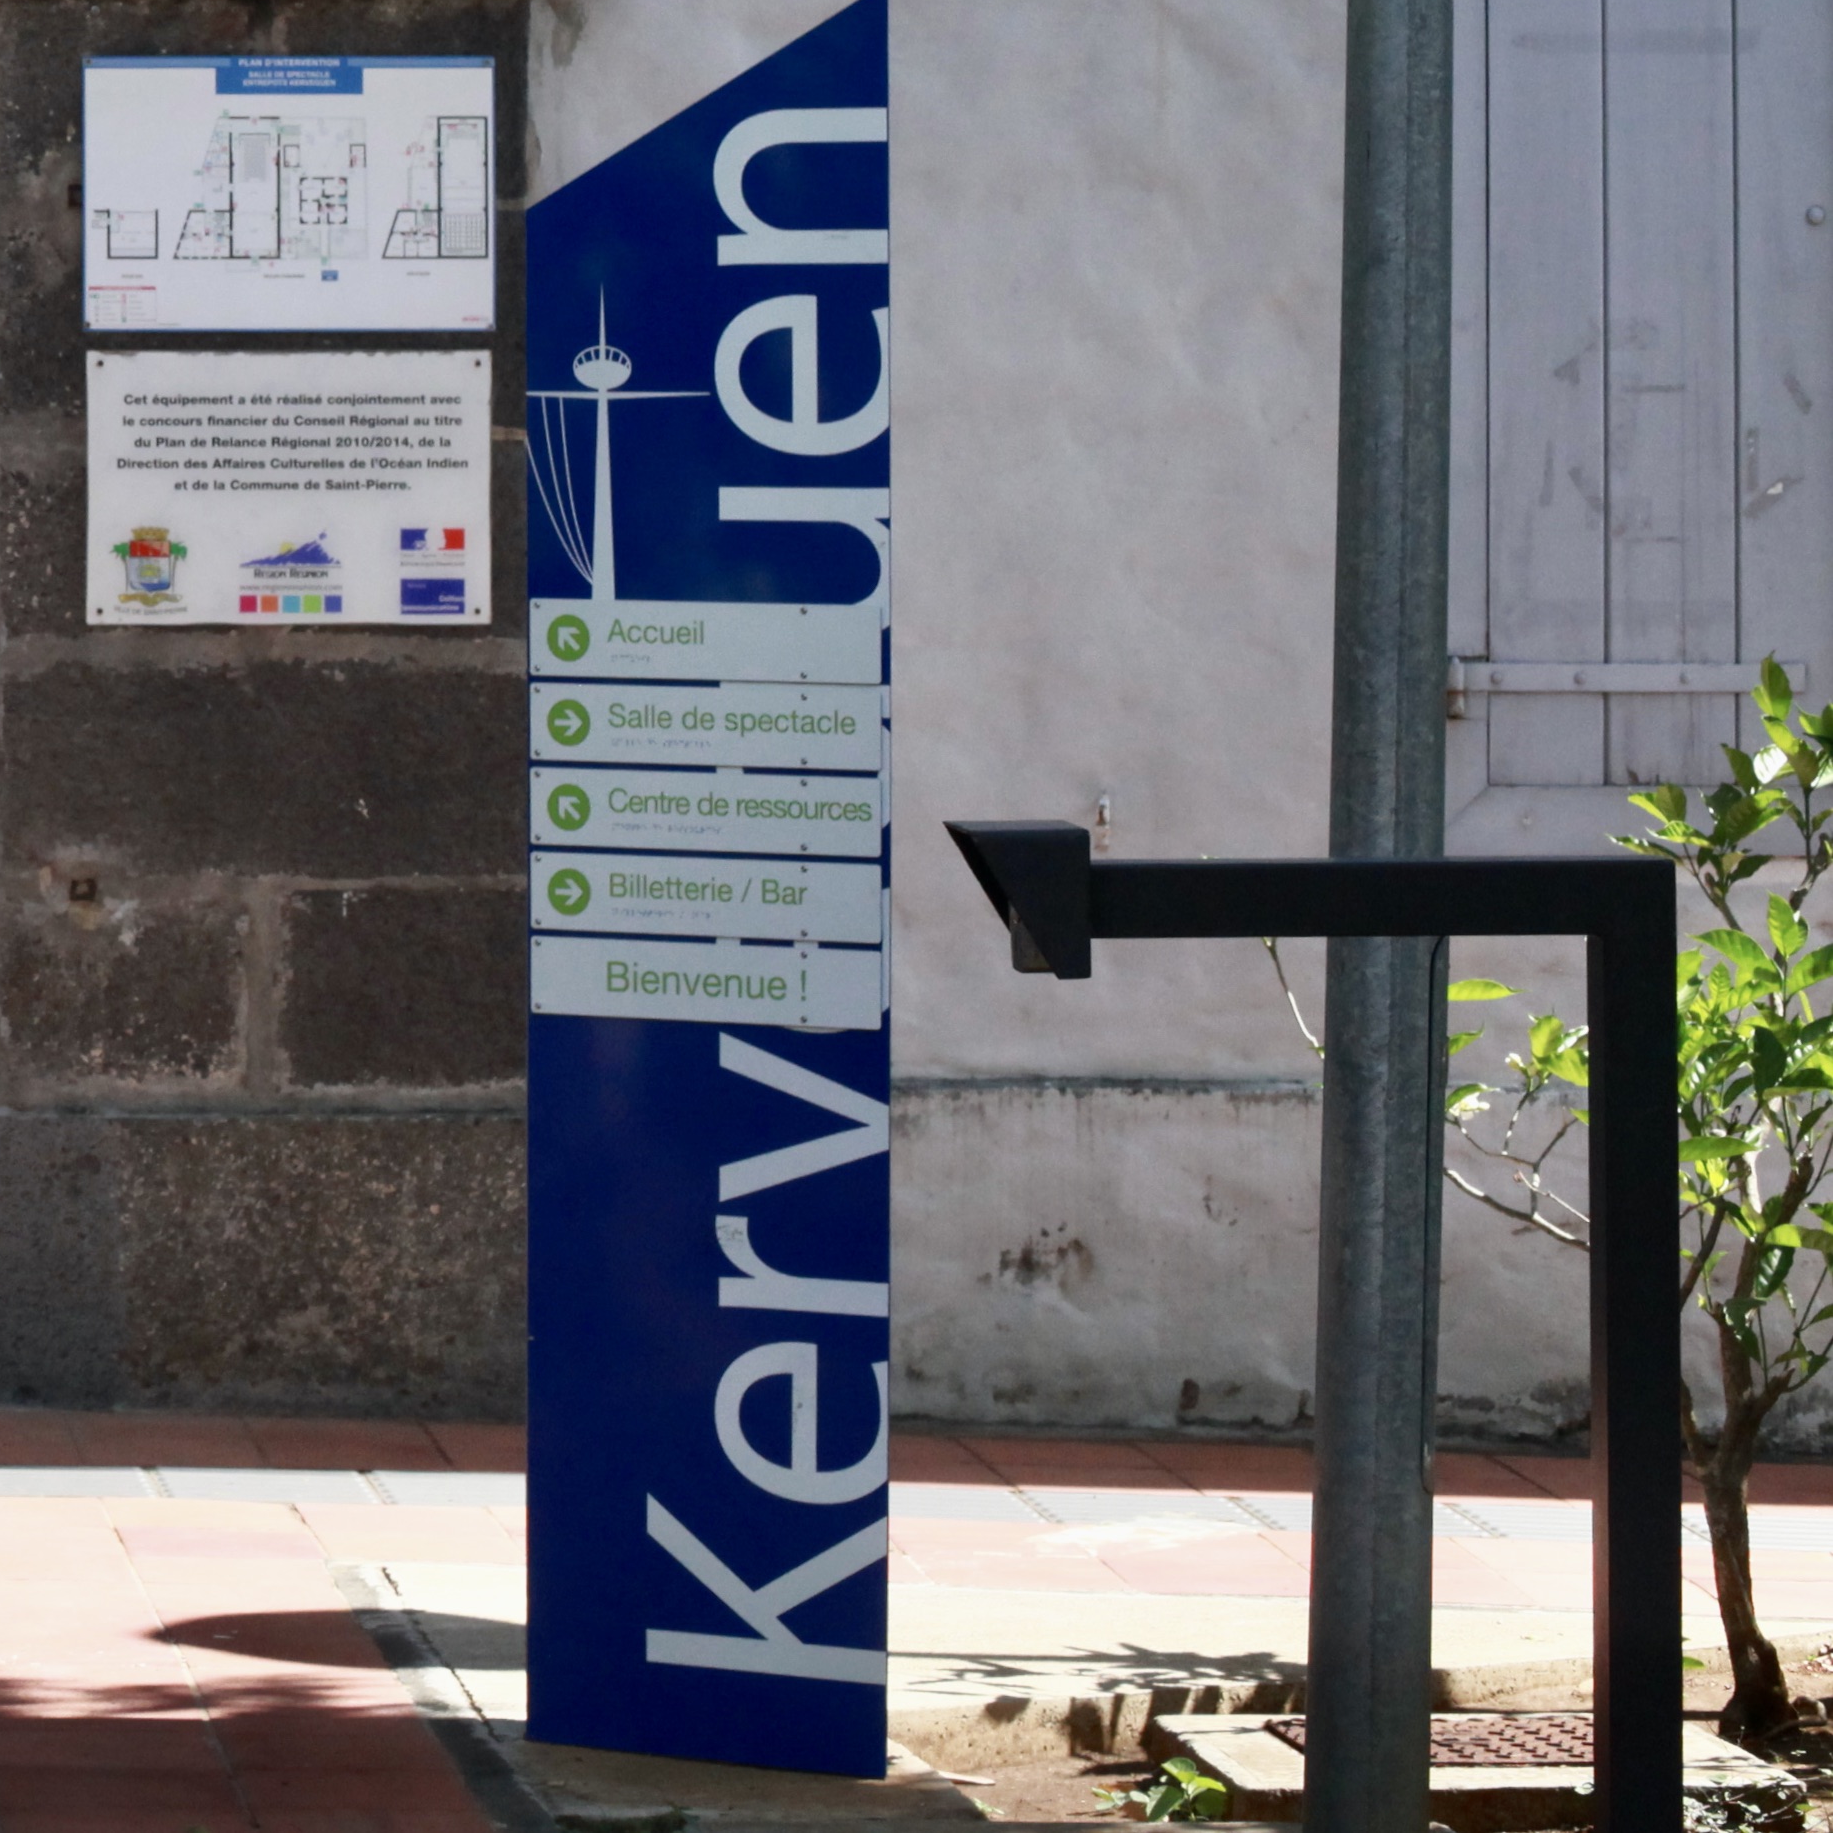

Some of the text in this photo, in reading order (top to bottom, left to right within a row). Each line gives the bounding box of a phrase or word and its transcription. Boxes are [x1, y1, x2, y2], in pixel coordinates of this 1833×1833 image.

[238, 58, 263, 67] PLAN
[124, 394, 462, 407] Cet équipement a été réalisé conjointement avec
[123, 416, 462, 428] le concours financier du Conseil Régional au titre
[134, 437, 451, 449] du Plan de Relance Régional 2010/2014, de la
[117, 458, 469, 469] Direction des Affaires Culturelles de l'Océan Indien
[174, 479, 411, 490] et de la Commune de Saint-Pierre.
[607, 618, 704, 645] Accueil
[608, 703, 856, 737] Salle de spectacle
[608, 787, 873, 822] Centre de ressources
[609, 873, 808, 905] Billetterie / Bar
[647, 107, 890, 1686] Kervuen
[606, 961, 807, 1001] Bienvenue !
